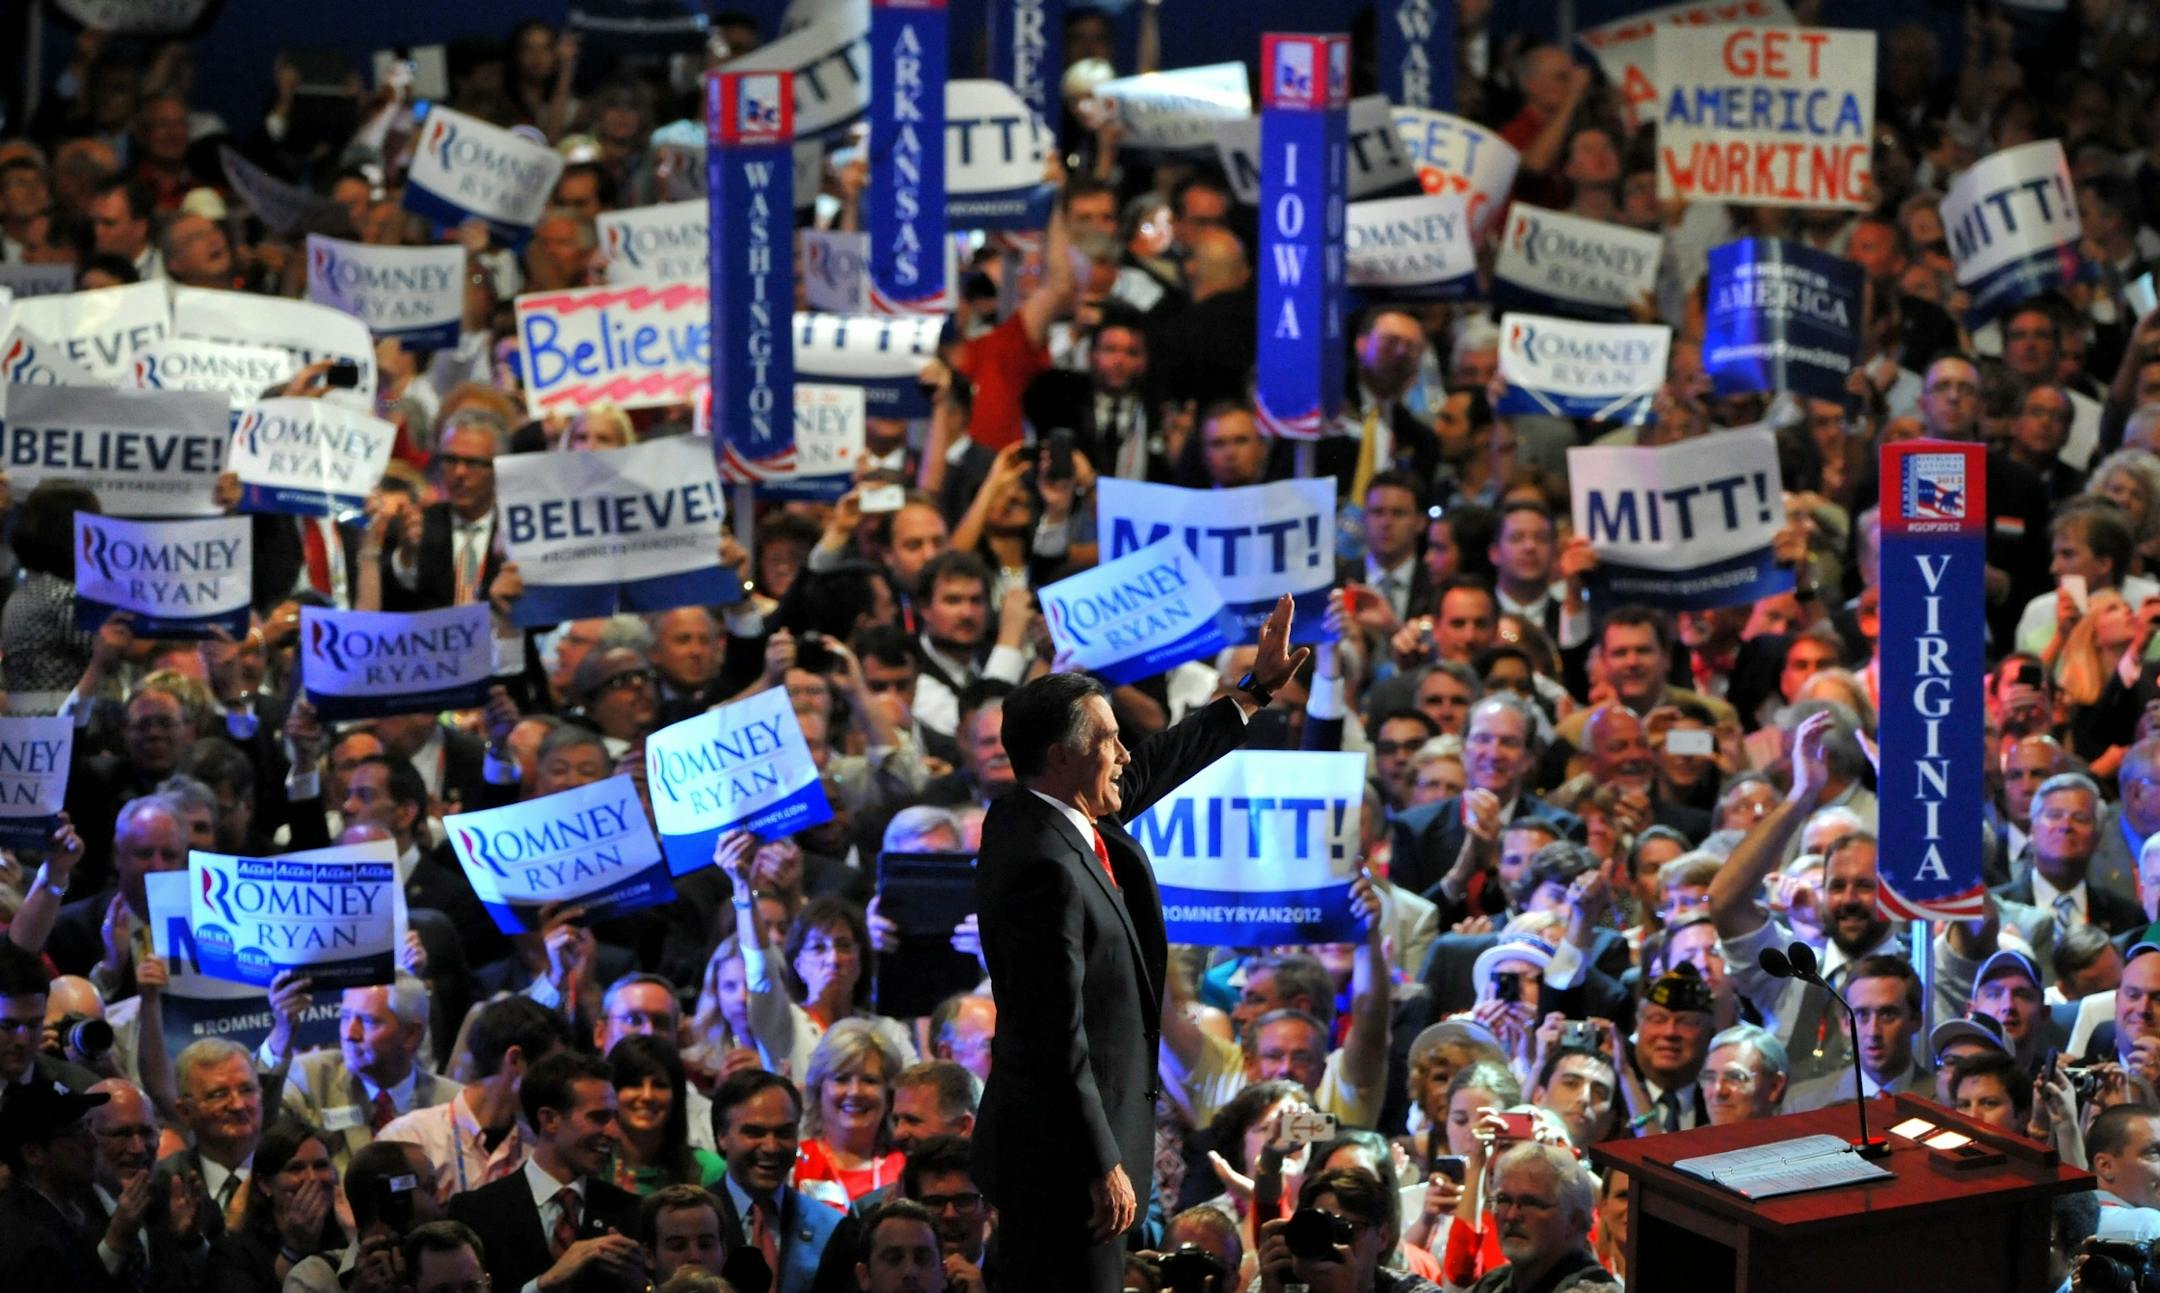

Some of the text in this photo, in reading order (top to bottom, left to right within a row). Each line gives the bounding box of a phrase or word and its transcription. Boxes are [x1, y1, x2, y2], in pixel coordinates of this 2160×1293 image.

[1723, 27, 1830, 80] GET
[1665, 85, 1863, 137] AMERICA
[893, 24, 922, 287] ARKANSAS
[1662, 141, 1873, 203] WORKING
[1273, 142, 1308, 340] IOWA
[1954, 174, 2073, 260] MITT!
[315, 246, 453, 297] ROMNEY
[742, 160, 774, 443] WASHINGTON
[11, 427, 223, 473] BELIEVE!
[238, 410, 382, 460] ROMNEY
[268, 451, 351, 483] RYAN
[507, 481, 722, 544] BELIEVE!
[1588, 472, 1772, 543] MITT!
[1907, 522, 1961, 532] #GOP2012
[82, 523, 242, 582] ROMNEY
[129, 577, 221, 605] RYAN
[1050, 556, 1189, 646] ROMNEY
[311, 619, 480, 672] ROMNEY
[1103, 599, 1193, 651] RYAN
[366, 656, 460, 685] RYAN
[1912, 554, 1954, 882] VIRGINIA
[652, 713, 786, 802] ROMNEY
[688, 762, 779, 815] RYAN
[459, 799, 630, 878] ROMNEY
[1131, 798, 1348, 859] MITT!
[201, 866, 382, 925] ROMNEY
[526, 845, 623, 893] RYAN
[257, 922, 358, 949] RYAN
